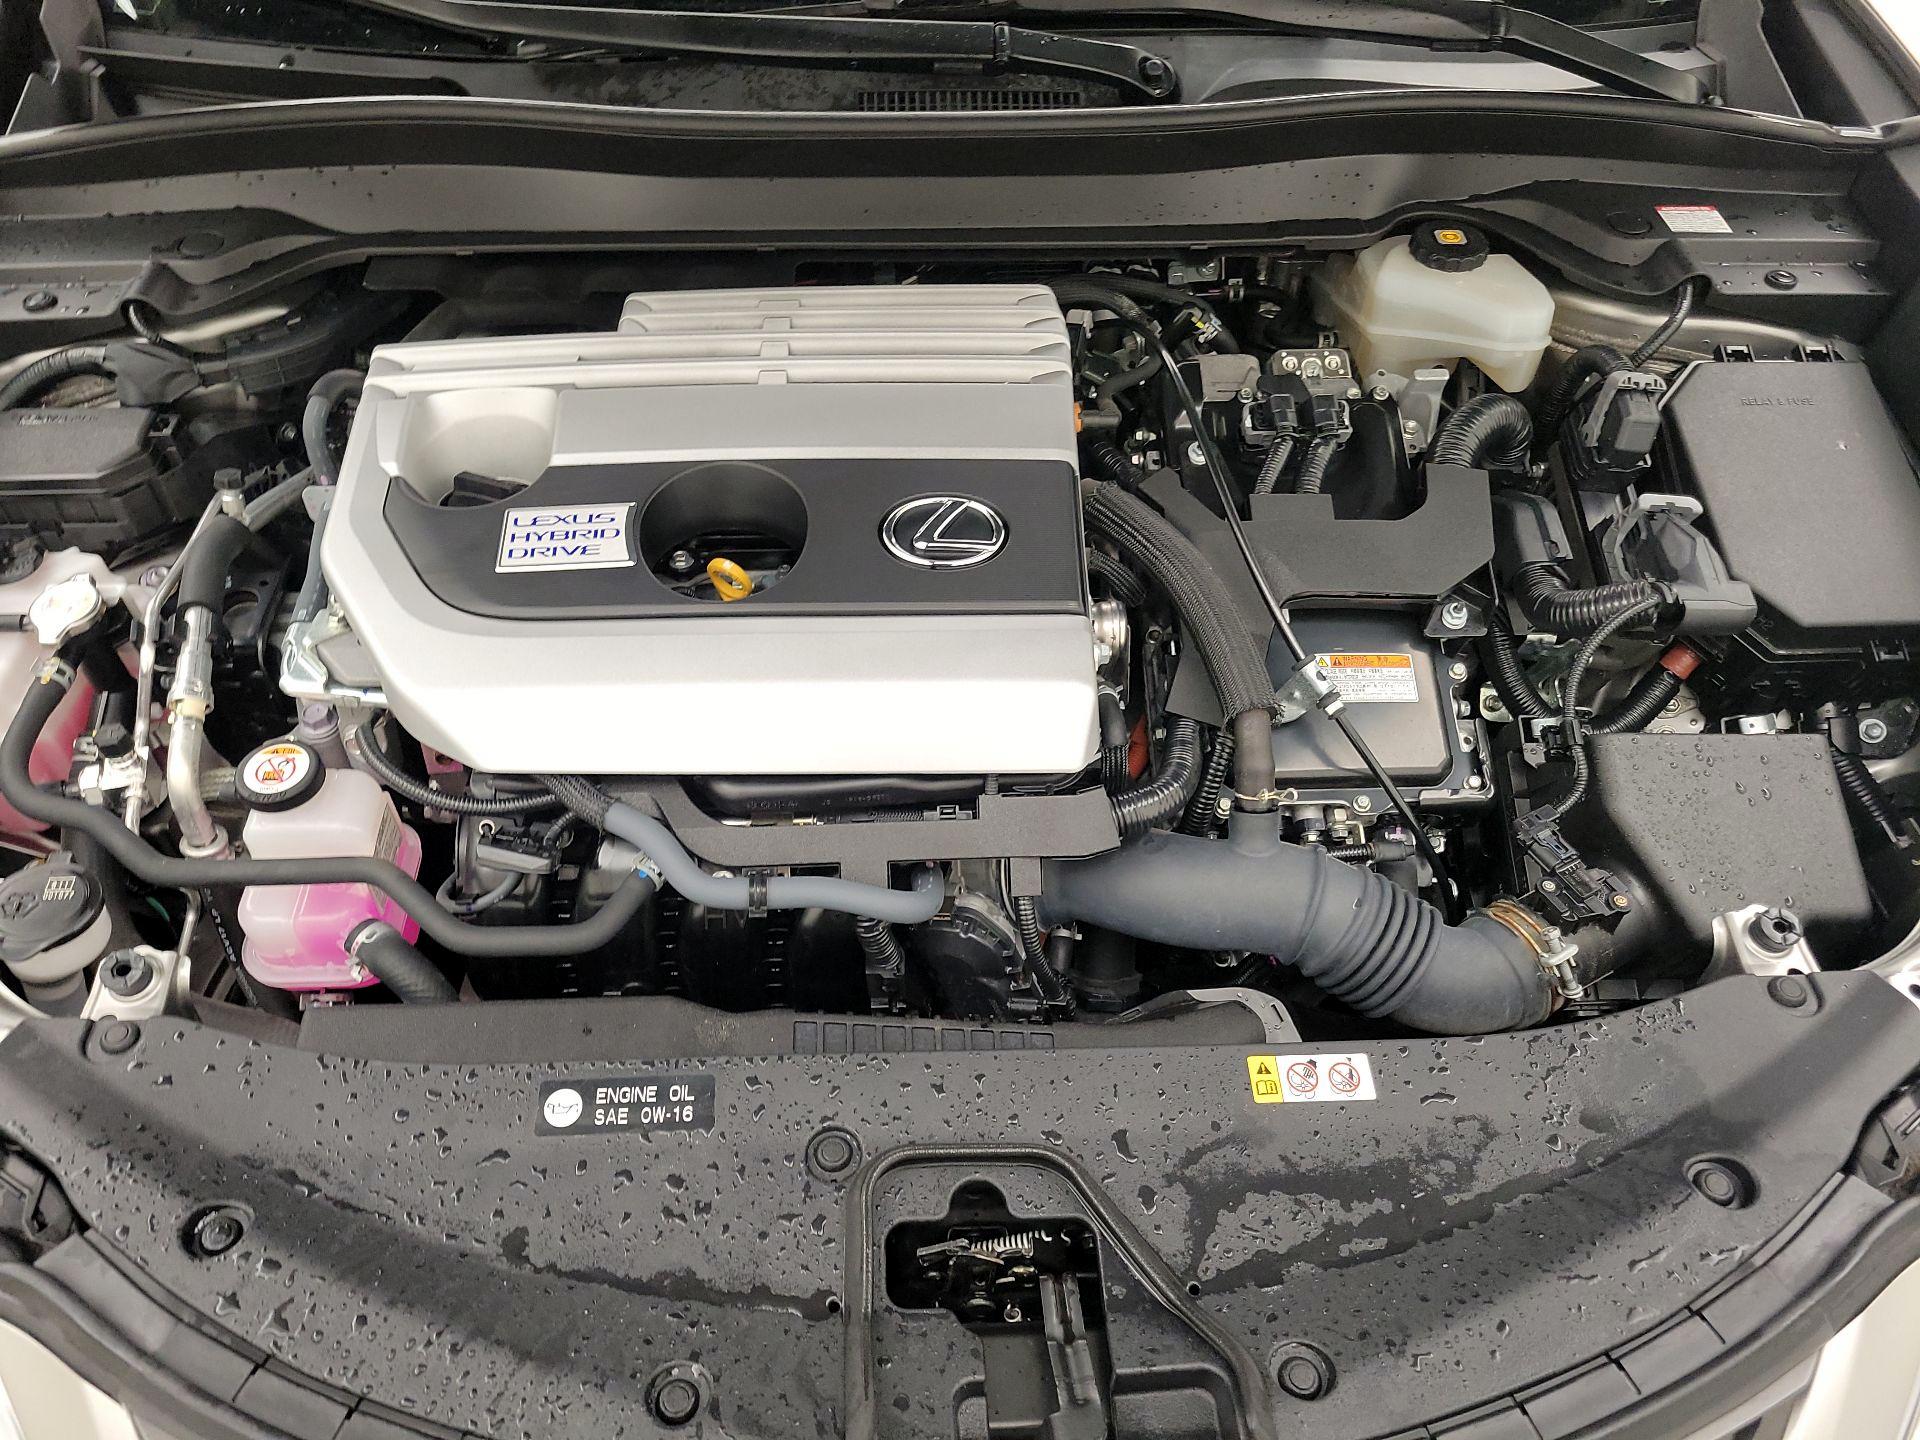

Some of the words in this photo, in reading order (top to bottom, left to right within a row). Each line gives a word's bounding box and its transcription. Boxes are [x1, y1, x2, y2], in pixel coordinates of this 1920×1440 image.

[1740, 397, 1774, 406] RELAY
[1787, 397, 1816, 406] FUSE
[513, 512, 616, 527] LEXUS
[510, 527, 621, 543] HYBRID
[507, 543, 602, 559] DRIVE
[595, 1086, 658, 1104] ENGINE
[669, 1084, 695, 1102] OIL
[594, 1107, 629, 1126] SAE
[640, 1105, 694, 1124] 0W-16
